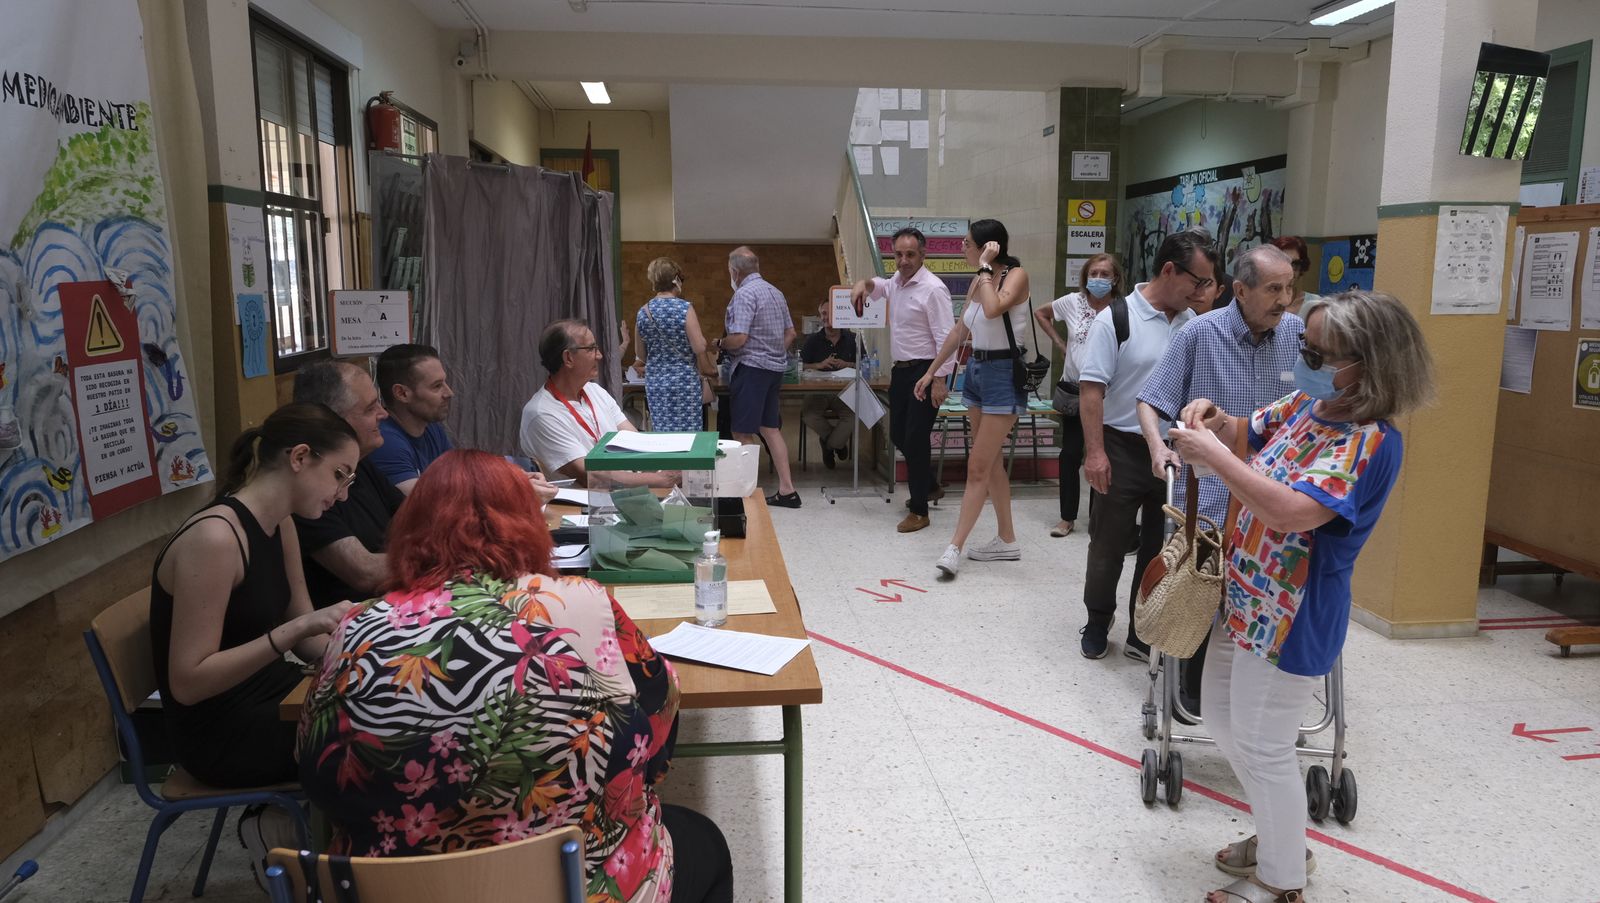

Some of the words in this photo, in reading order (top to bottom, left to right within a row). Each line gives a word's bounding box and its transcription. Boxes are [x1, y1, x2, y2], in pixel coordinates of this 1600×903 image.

[1199, 169, 1218, 184] OFICIAL
[908, 221, 958, 233] FELICES
[1070, 230, 1105, 238] ESCALERA
[380, 312, 387, 320] A
[94, 372, 106, 380] ESTA
[107, 369, 125, 378] BASURA
[99, 379, 121, 389] RECOGIDA
[86, 391, 107, 401] NUESTRO
[108, 388, 123, 397] PATIO
[95, 404, 100, 413] 1
[99, 420, 122, 432] IMAGINAS
[123, 417, 135, 425] TODA
[100, 430, 118, 441] BASURA
[119, 428, 128, 436] QUE
[103, 438, 126, 449] RECICLAS
[117, 445, 133, 456] CURSO?
[94, 471, 118, 484] PIENSA
[119, 468, 124, 476] Y
[126, 460, 145, 474] ACTÚA
